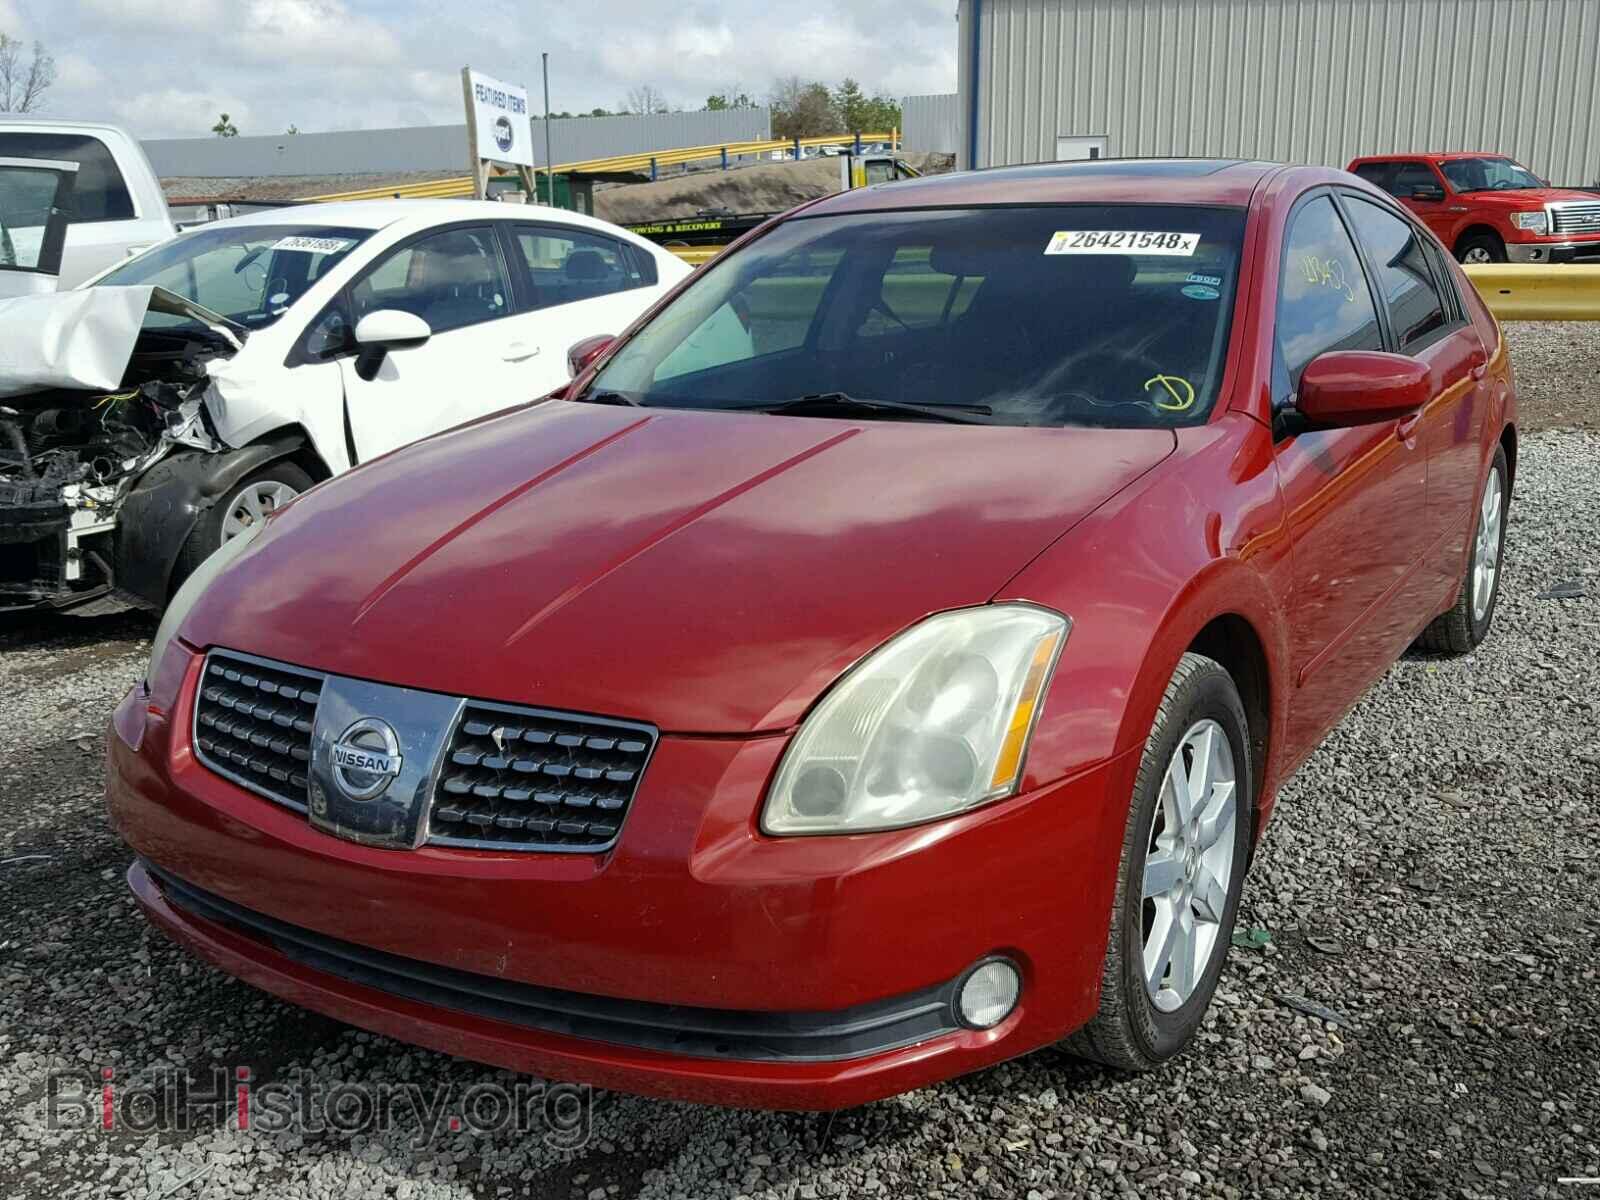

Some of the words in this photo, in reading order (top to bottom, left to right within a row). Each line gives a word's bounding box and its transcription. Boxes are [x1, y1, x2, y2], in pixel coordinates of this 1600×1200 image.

[475, 83, 506, 109] FEATURED
[507, 94, 526, 115] ITEMS
[674, 222, 721, 232] RECOVERY
[335, 750, 390, 772] NISSAN
